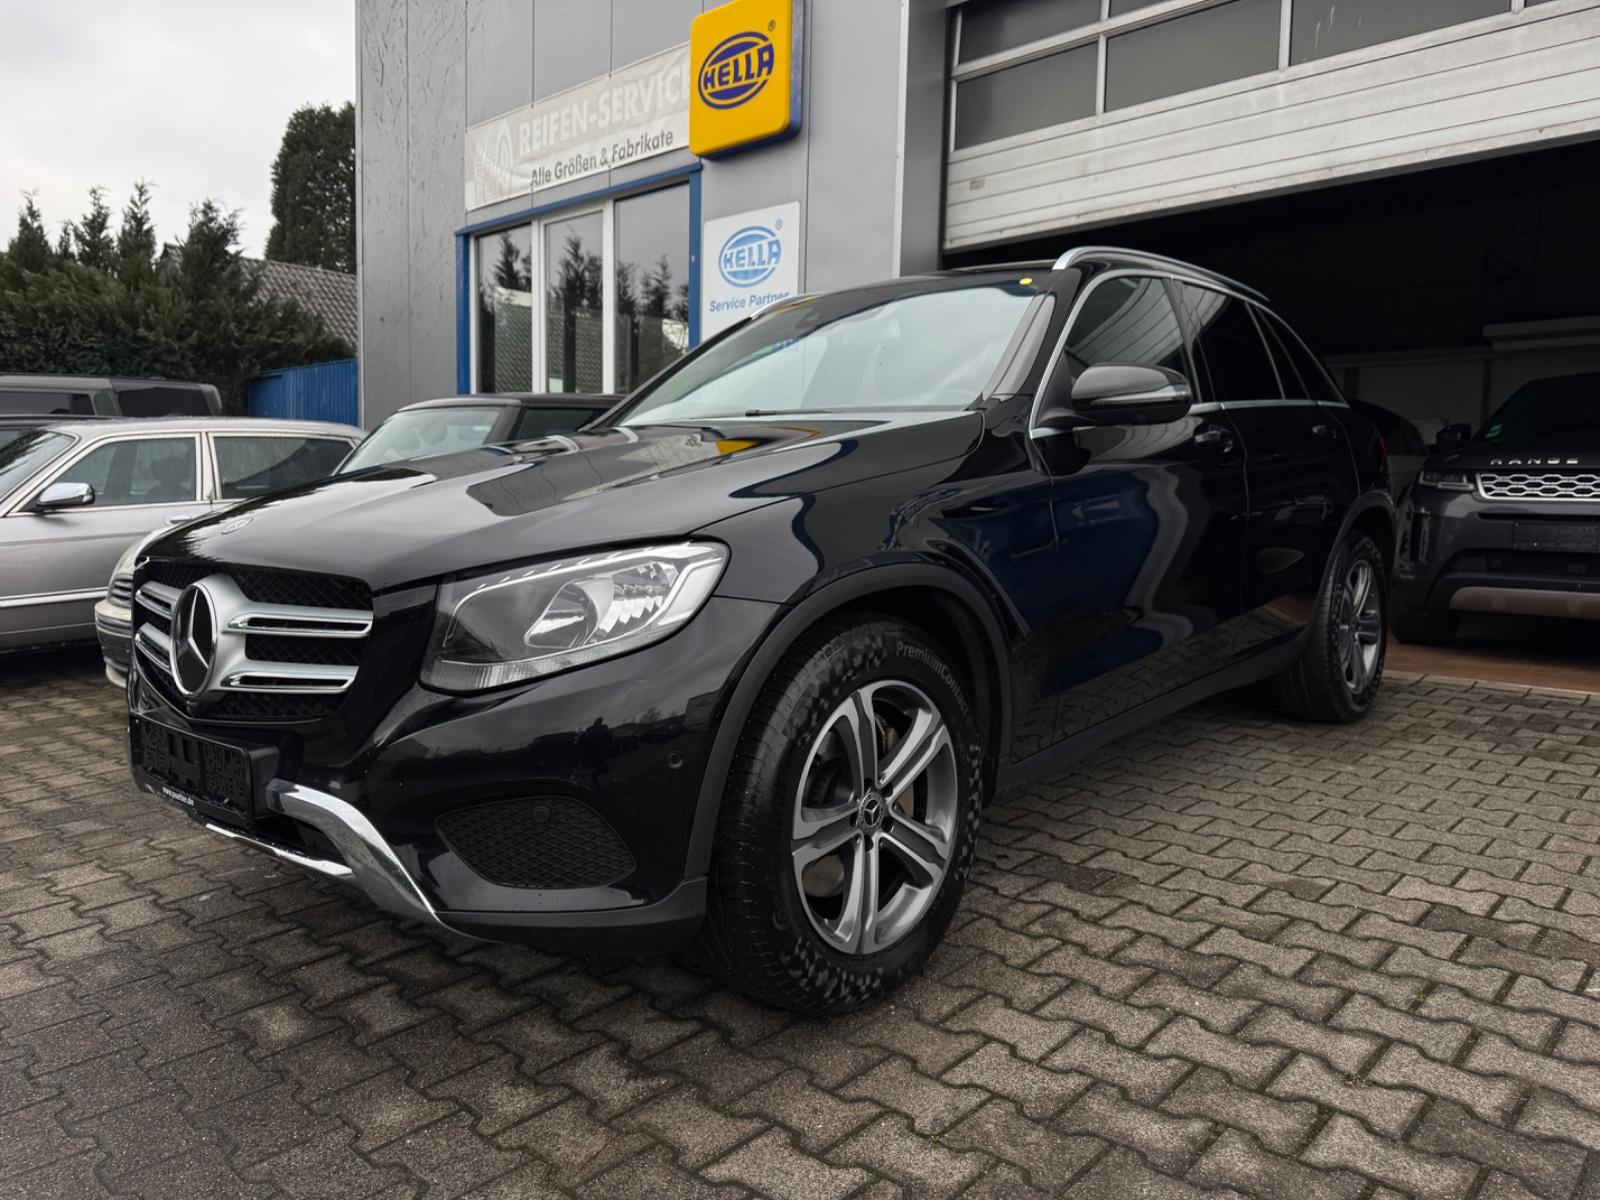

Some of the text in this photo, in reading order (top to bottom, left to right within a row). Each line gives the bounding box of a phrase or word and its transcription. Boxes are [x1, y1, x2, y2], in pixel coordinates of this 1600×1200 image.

[703, 43, 774, 91] HELLA
[531, 130, 674, 187] Alle Größen & Fabrikate
[723, 239, 782, 269] HELLA
[709, 297, 746, 312] Service
